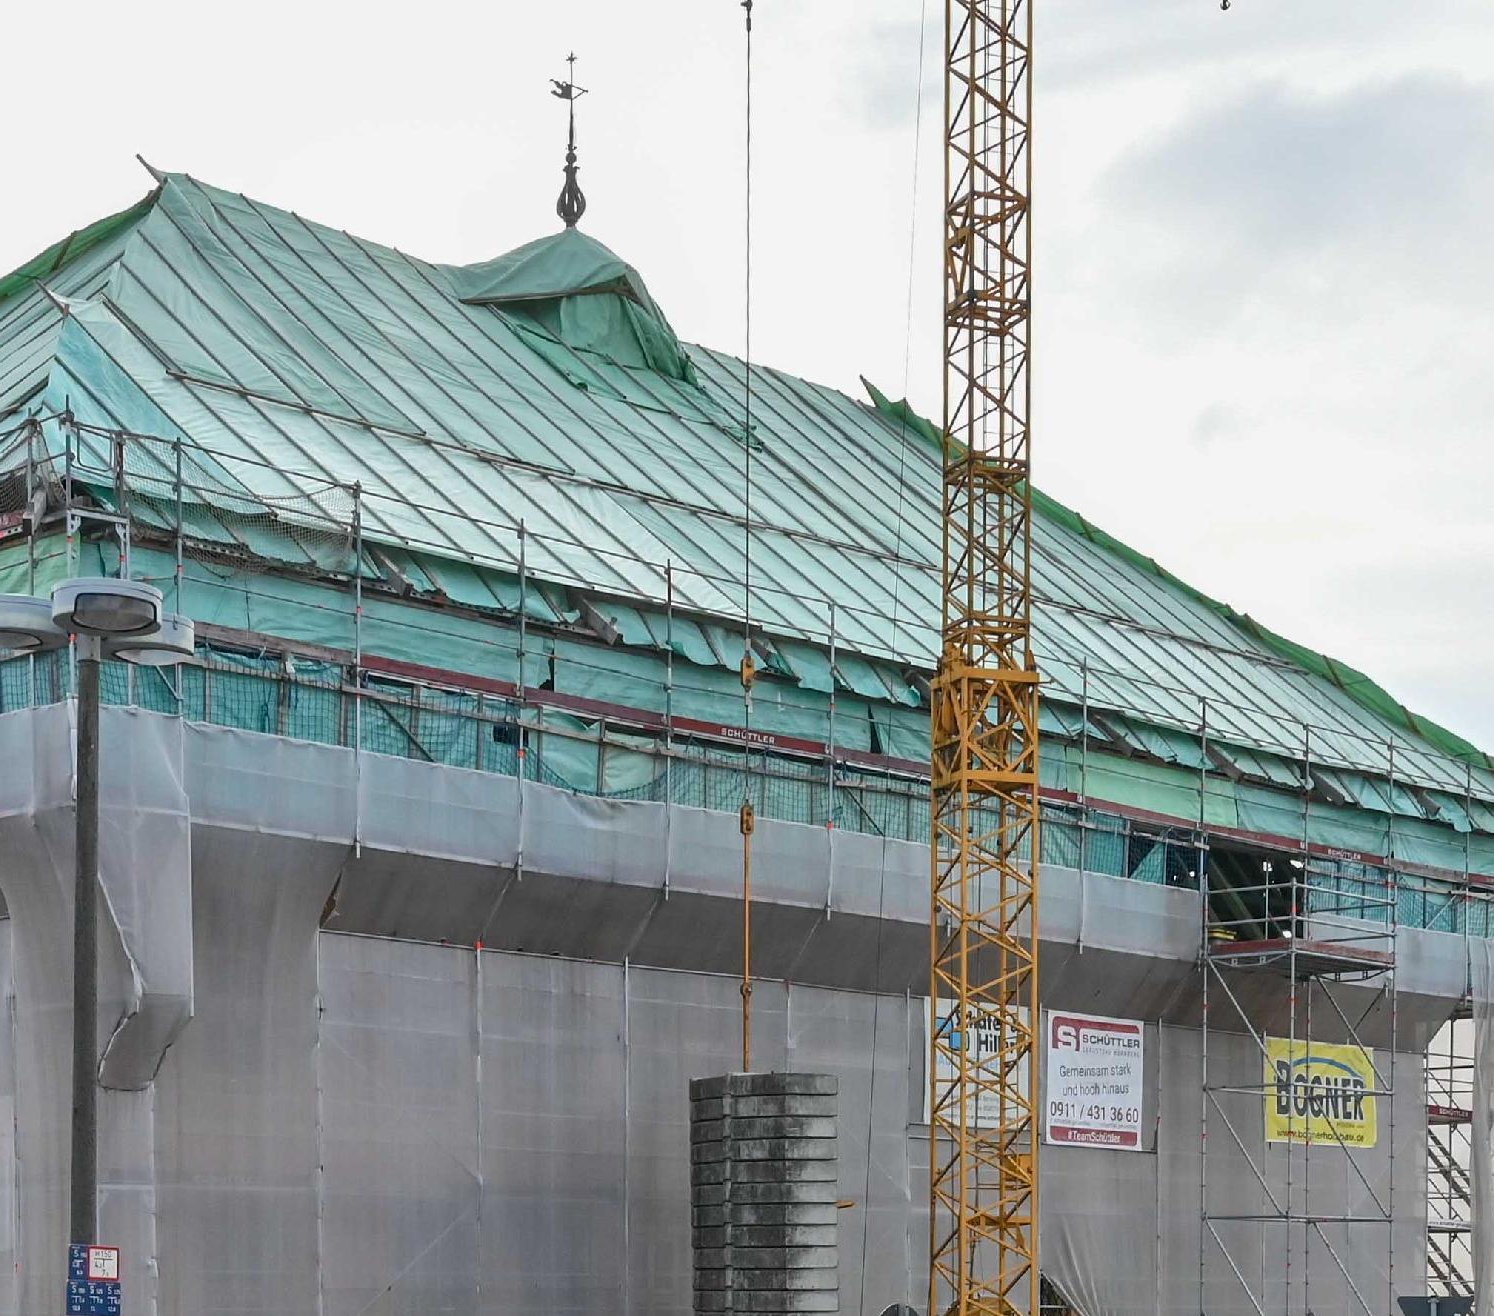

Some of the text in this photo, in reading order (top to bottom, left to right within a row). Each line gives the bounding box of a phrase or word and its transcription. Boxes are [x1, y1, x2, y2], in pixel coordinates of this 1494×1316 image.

[1082, 1034, 1140, 1049] SCHÜTTLER
[1060, 1062, 1131, 1077] Gemeinsam stark
[1062, 1083, 1129, 1097] und hoch hinaus
[1276, 1060, 1364, 1120] BOGNER
[1050, 1101, 1075, 1118] 0911
[1087, 1104, 1105, 1120] 431
[1110, 1107, 1123, 1121] 36
[1125, 1108, 1139, 1123] 60
[1067, 1130, 1121, 1143] #TeamSchüttler
